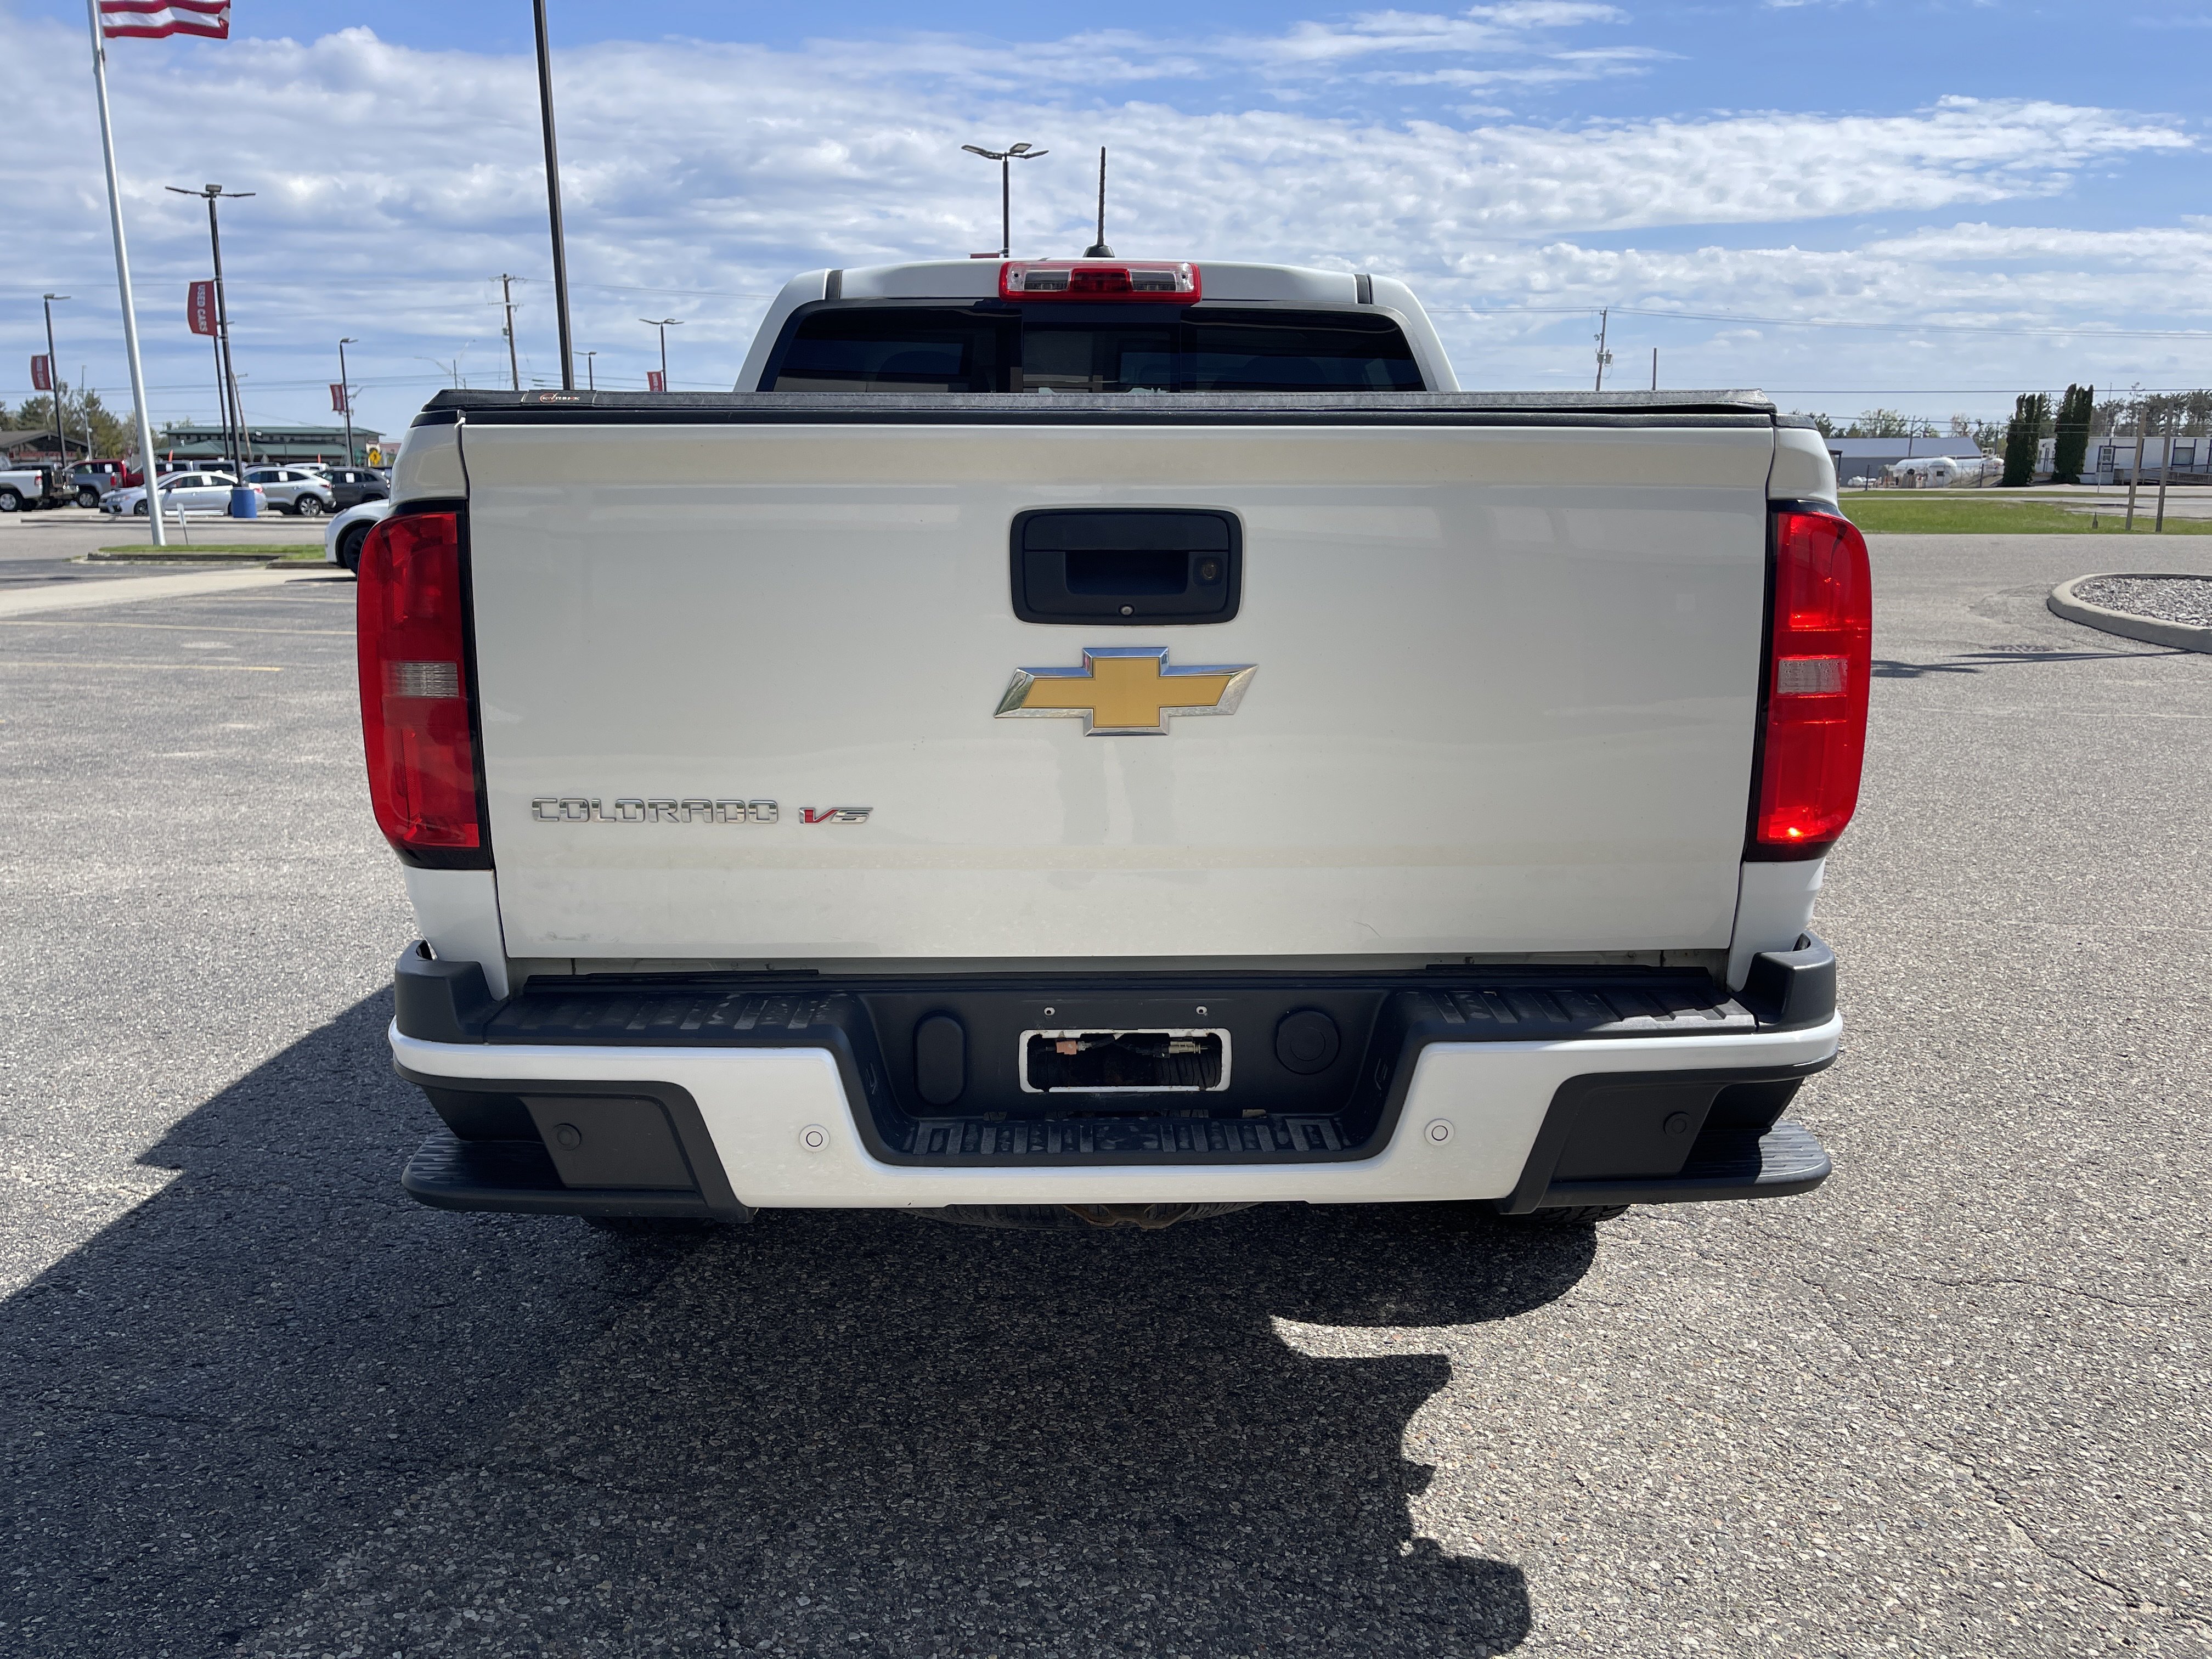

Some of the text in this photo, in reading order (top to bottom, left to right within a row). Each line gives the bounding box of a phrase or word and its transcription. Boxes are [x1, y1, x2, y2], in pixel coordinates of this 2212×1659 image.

[198, 284, 208, 332] USED CARS
[532, 798, 874, 824] COLORADO V6
